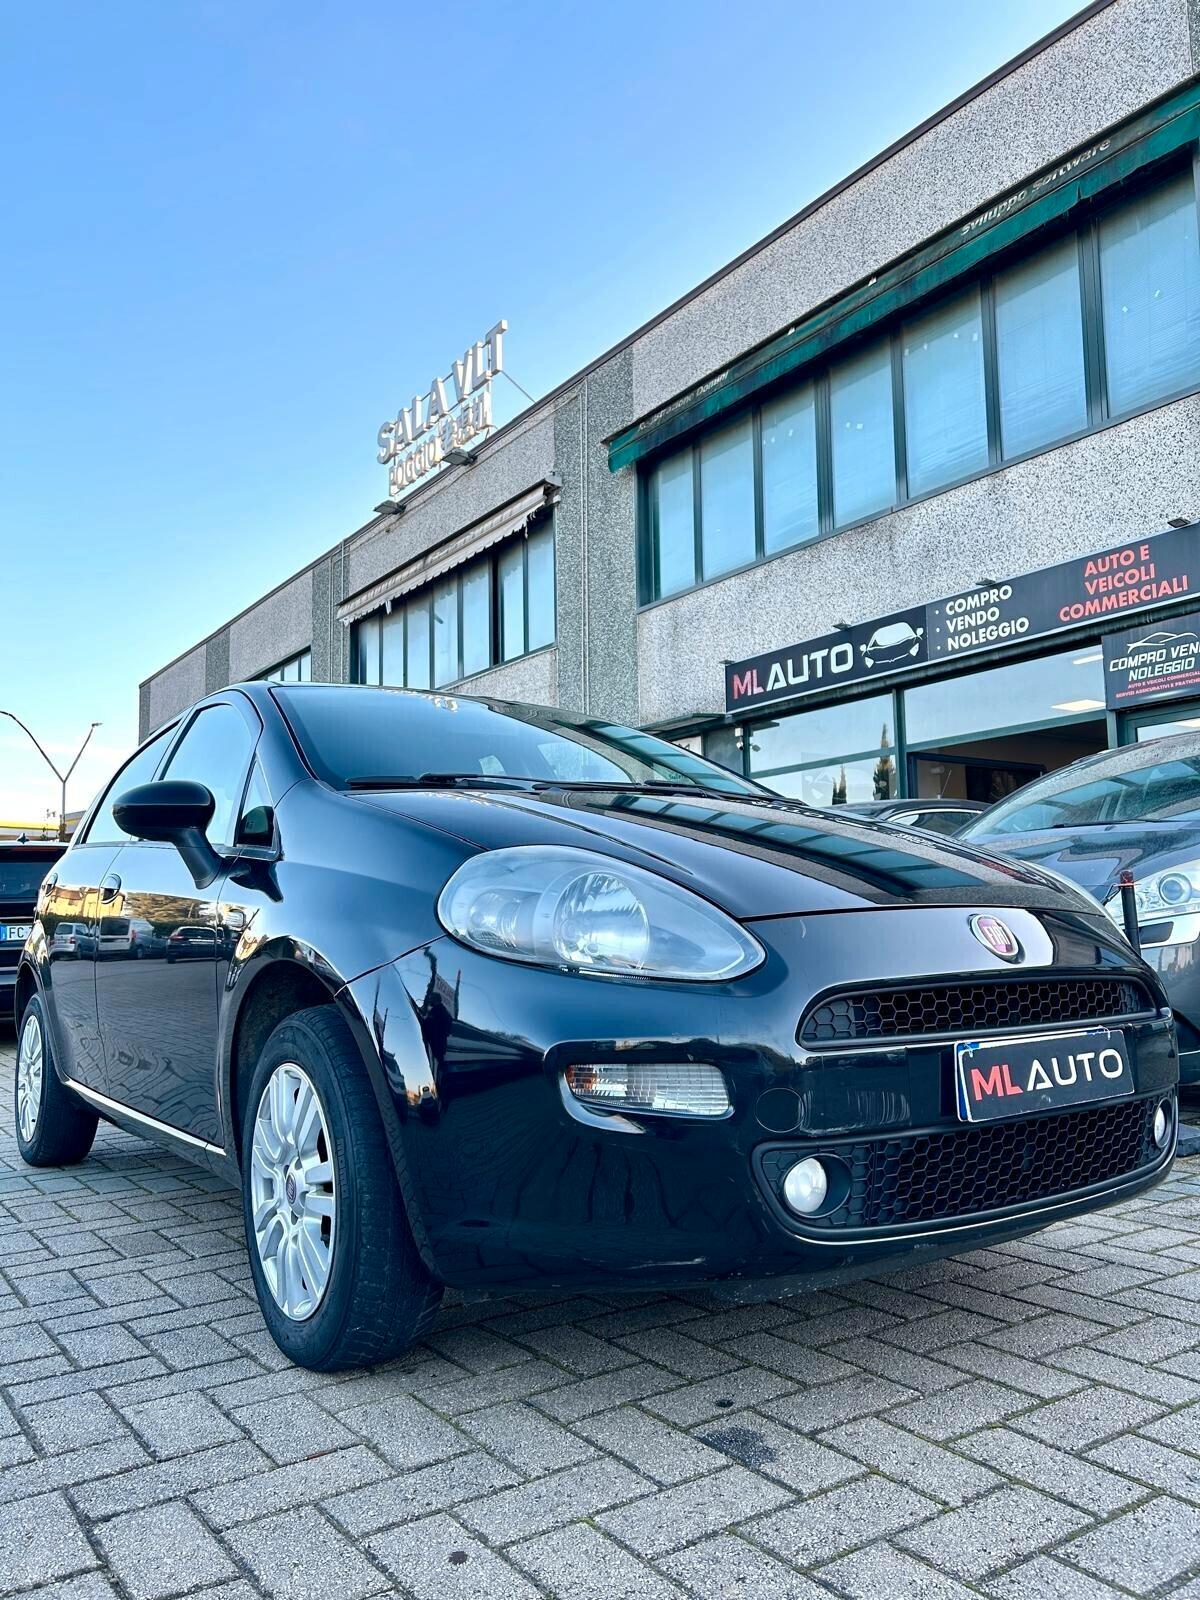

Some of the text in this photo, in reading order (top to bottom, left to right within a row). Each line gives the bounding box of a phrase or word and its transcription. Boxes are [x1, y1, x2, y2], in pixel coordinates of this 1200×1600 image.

[960, 190, 1027, 236] Sviluppo
[377, 376, 449, 464] SALA
[451, 319, 508, 404] VLT
[1084, 545, 1150, 577] AUTO E
[1085, 563, 1156, 595] VEICOLI
[945, 585, 1013, 615] COMPRO
[1059, 575, 1189, 622] COMMERCIALI
[946, 607, 1000, 633] VENDO
[947, 617, 1029, 651] NOLEGGIO
[1109, 641, 1200, 672] COMPRO VEN
[1129, 657, 1195, 681] NOLEGGIO
[982, 925, 1011, 946] FIAT
